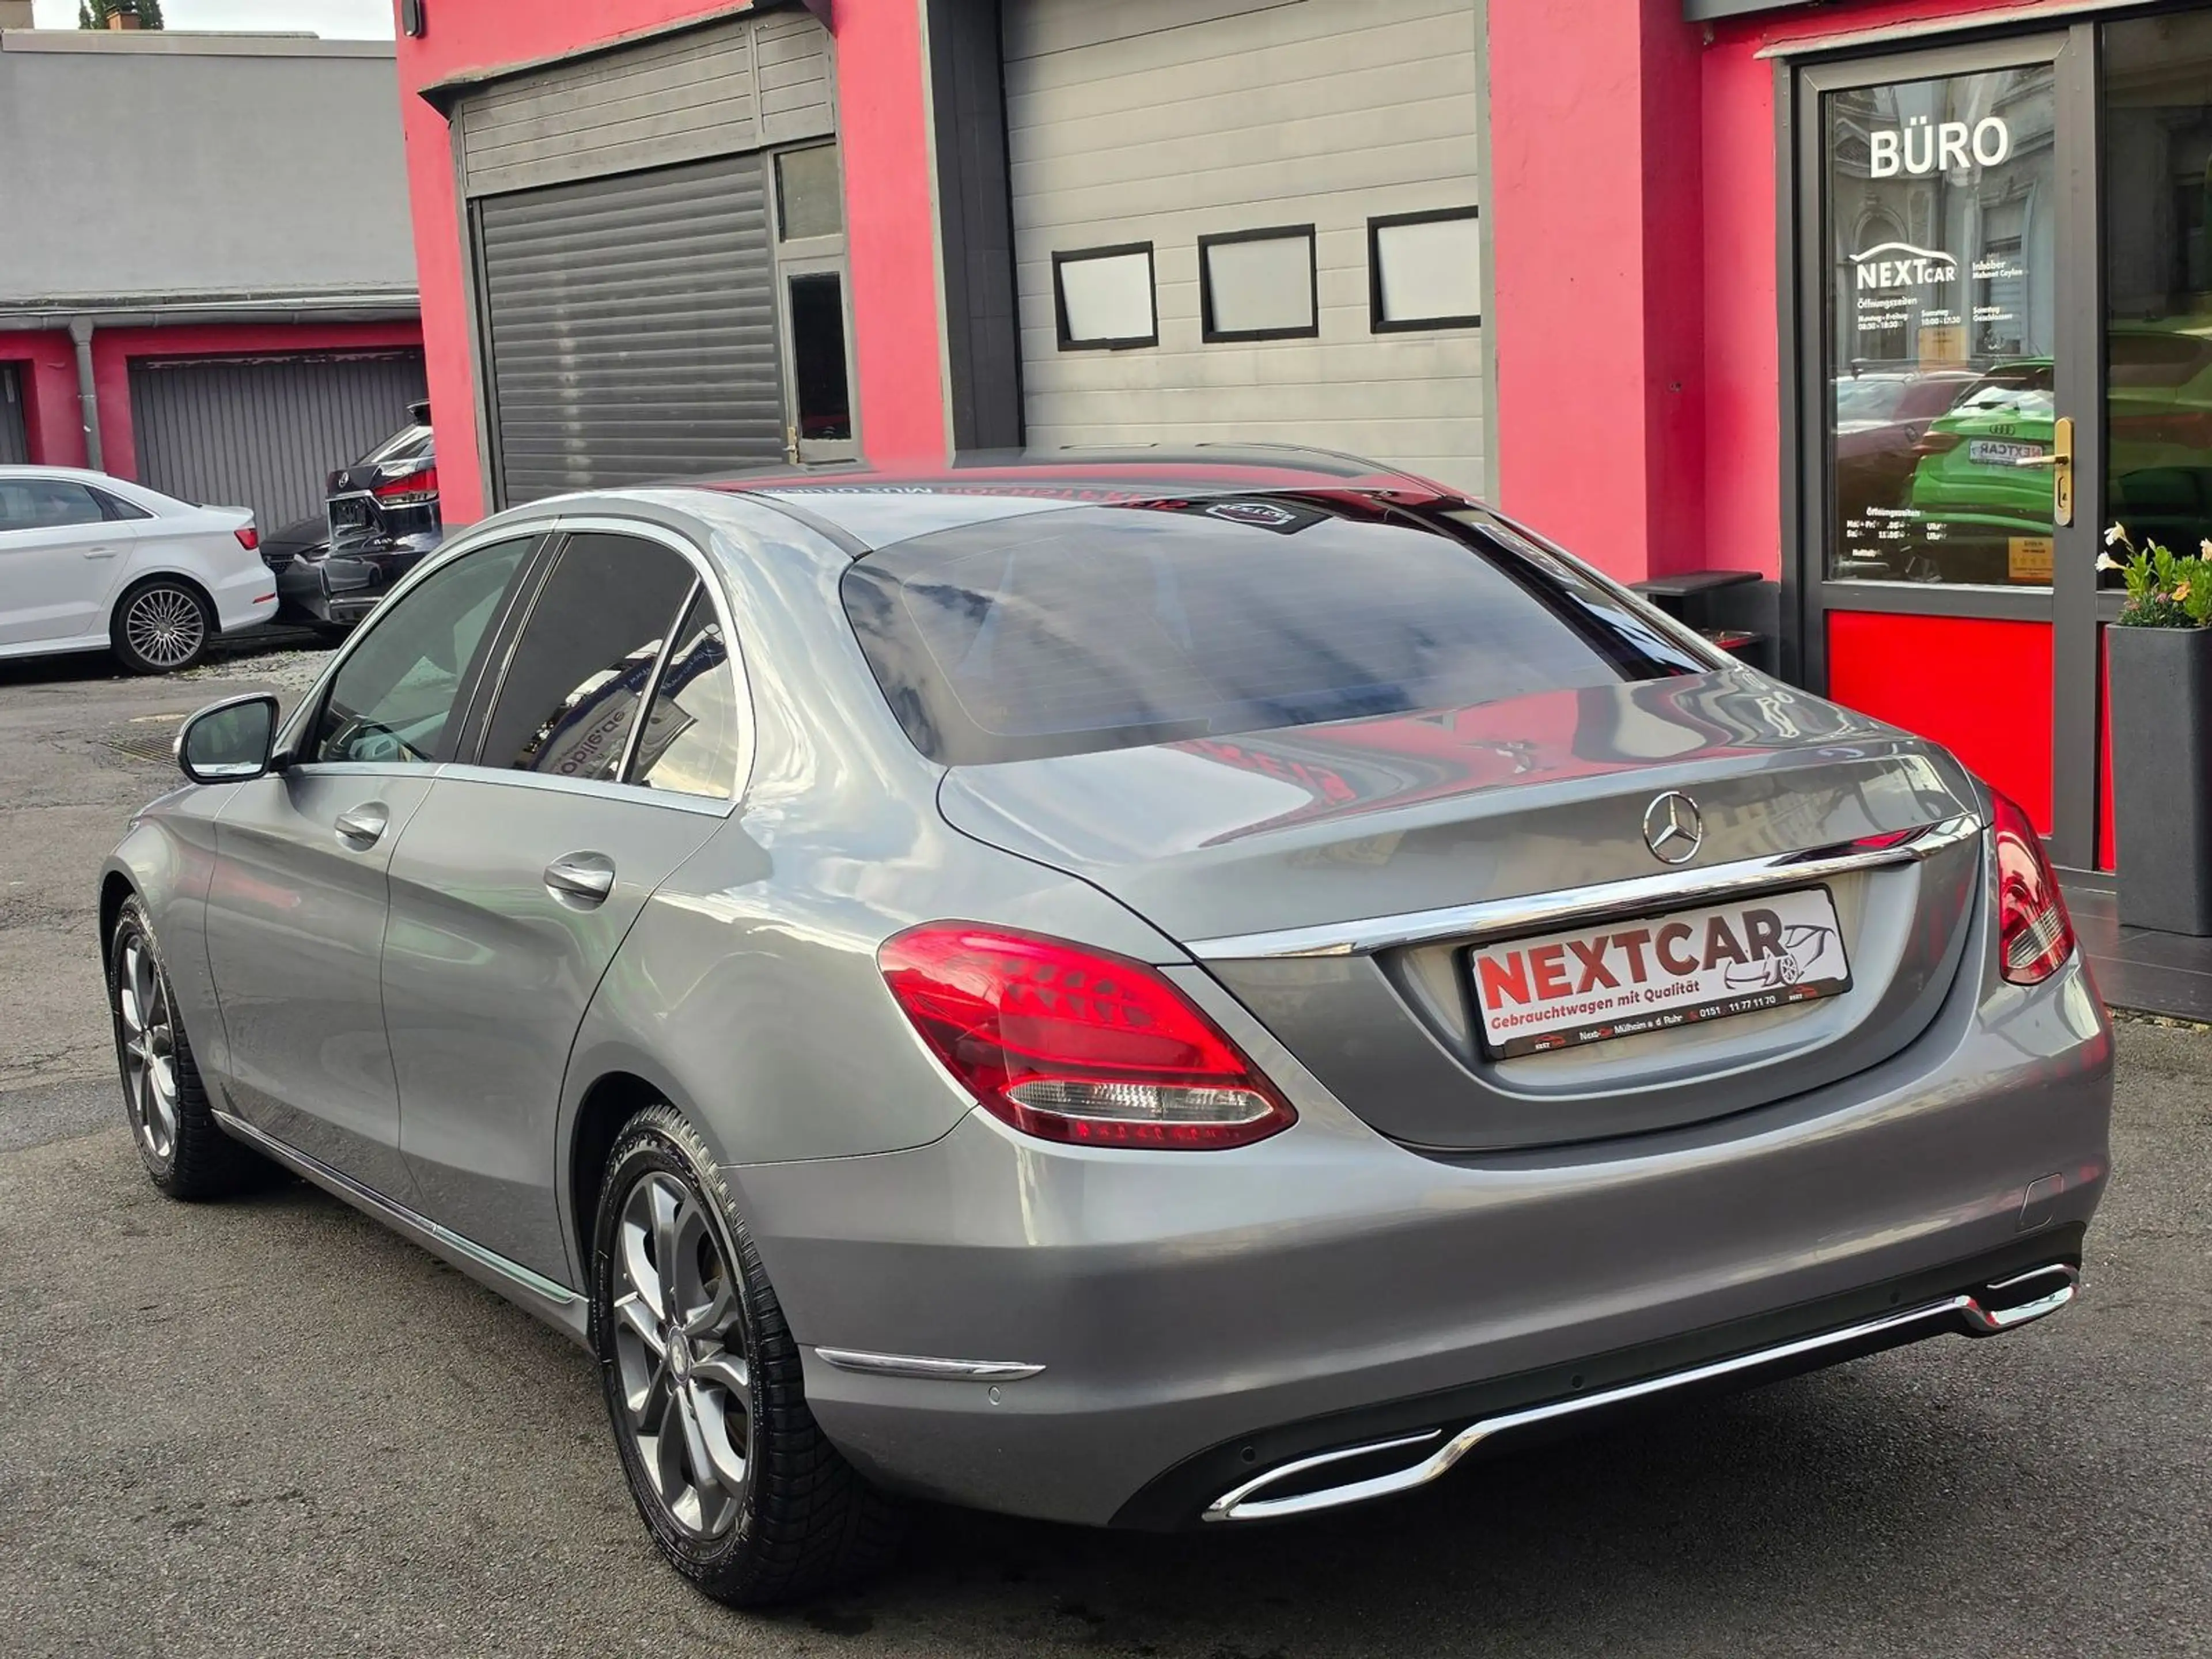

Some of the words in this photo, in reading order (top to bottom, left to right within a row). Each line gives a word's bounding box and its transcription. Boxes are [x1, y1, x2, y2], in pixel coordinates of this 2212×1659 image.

[1870, 115, 2009, 178] BÜRO
[1477, 908, 1788, 1010] NEXTCAR
[1491, 997, 1613, 1030] Gebrauchtwagen
[1618, 990, 1640, 1006] mit
[1644, 980, 1700, 1003] Qualität
[1699, 1006, 1721, 1018] 0151
